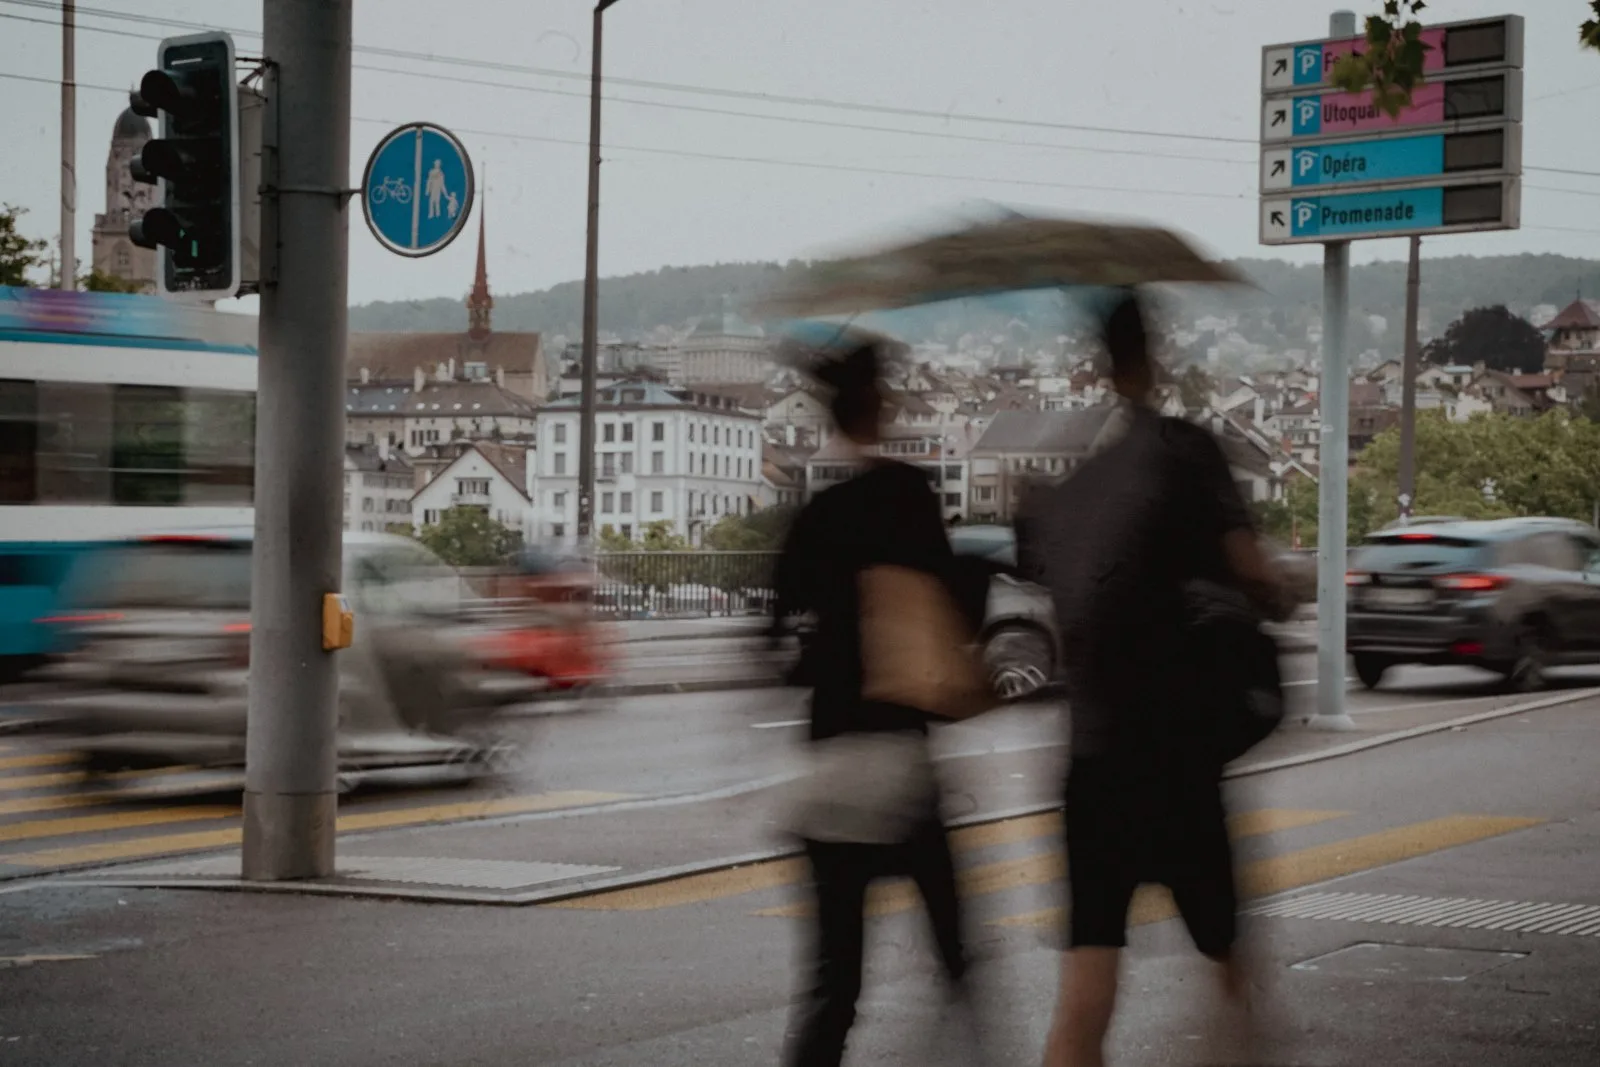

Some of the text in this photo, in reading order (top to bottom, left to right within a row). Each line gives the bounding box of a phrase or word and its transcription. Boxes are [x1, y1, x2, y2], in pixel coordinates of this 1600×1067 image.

[1301, 55, 1315, 76] P
[1301, 104, 1315, 126] P
[1300, 154, 1366, 178] P Opéra
[1299, 201, 1414, 228] P Promenade
